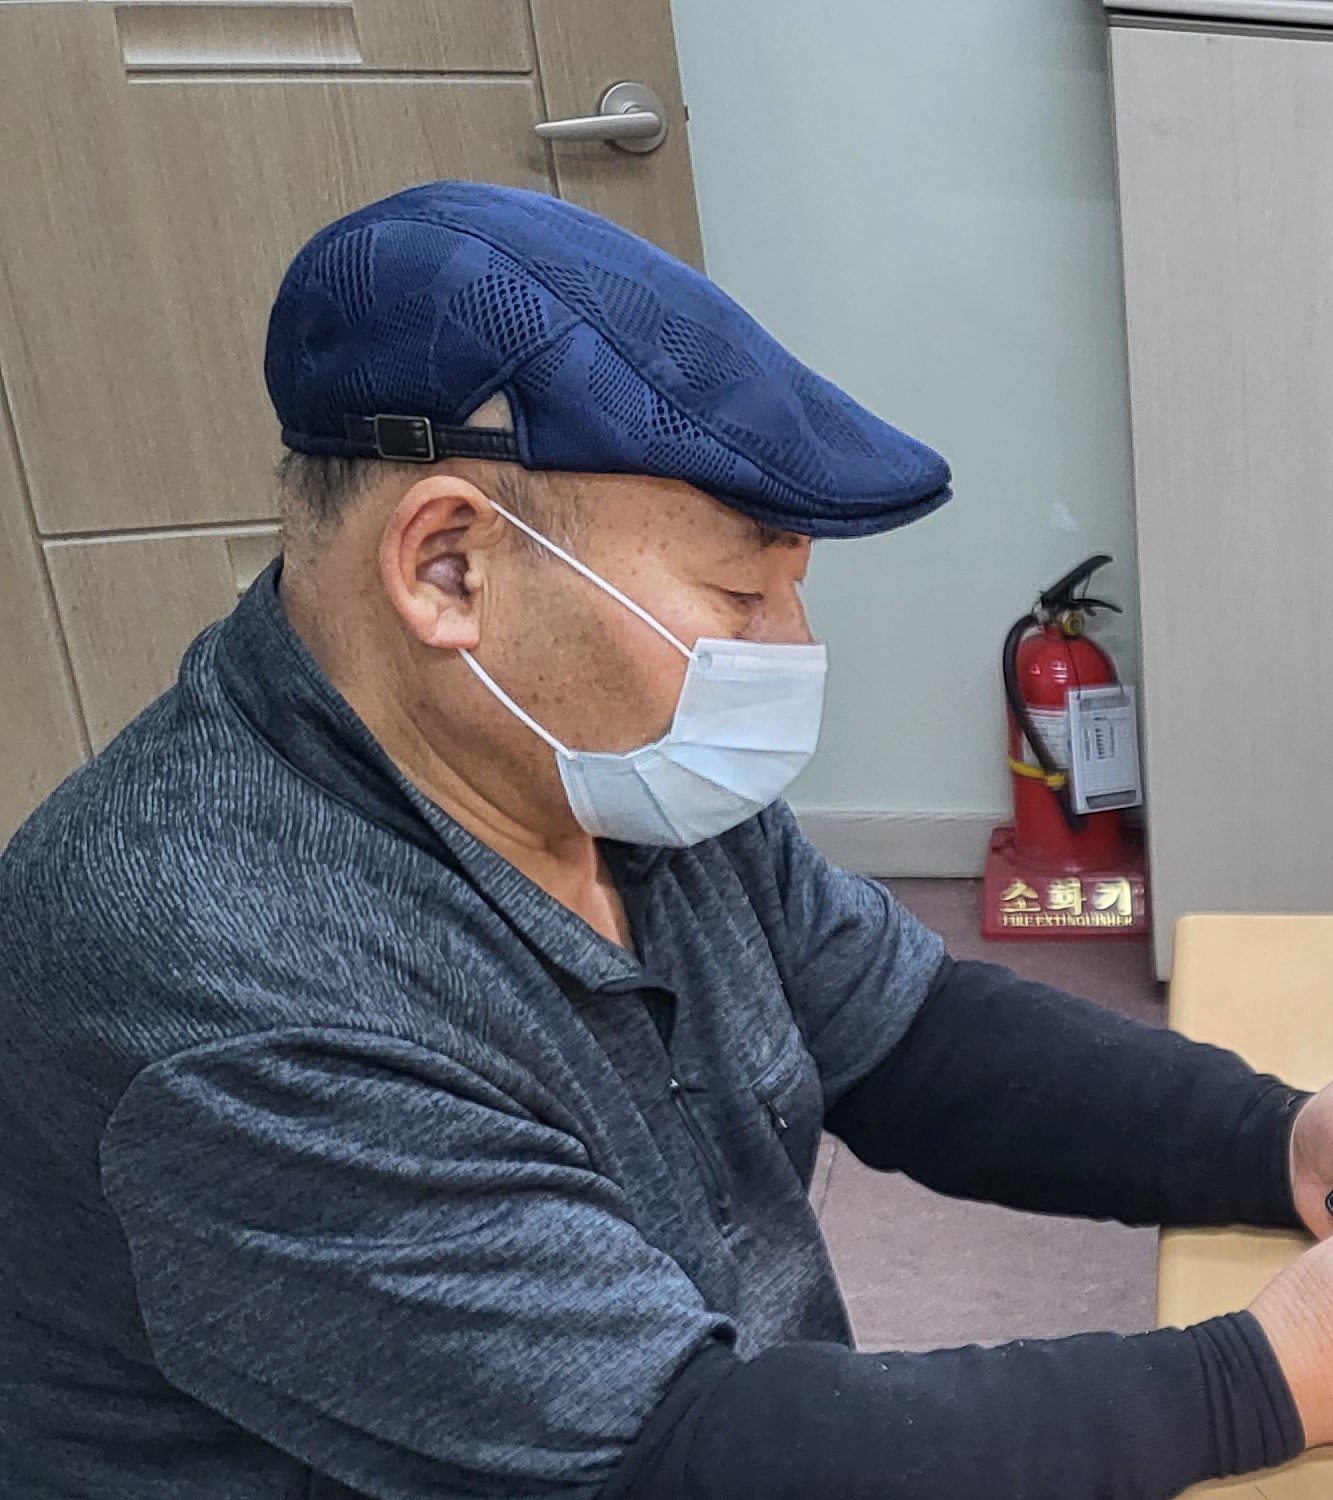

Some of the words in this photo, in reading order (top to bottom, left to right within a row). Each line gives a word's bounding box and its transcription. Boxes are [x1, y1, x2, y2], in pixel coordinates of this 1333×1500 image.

[1000, 876, 1132, 916] 소화기
[1003, 913, 1033, 926] FIRE
[1036, 912, 1133, 927] EXTINGUISHER
